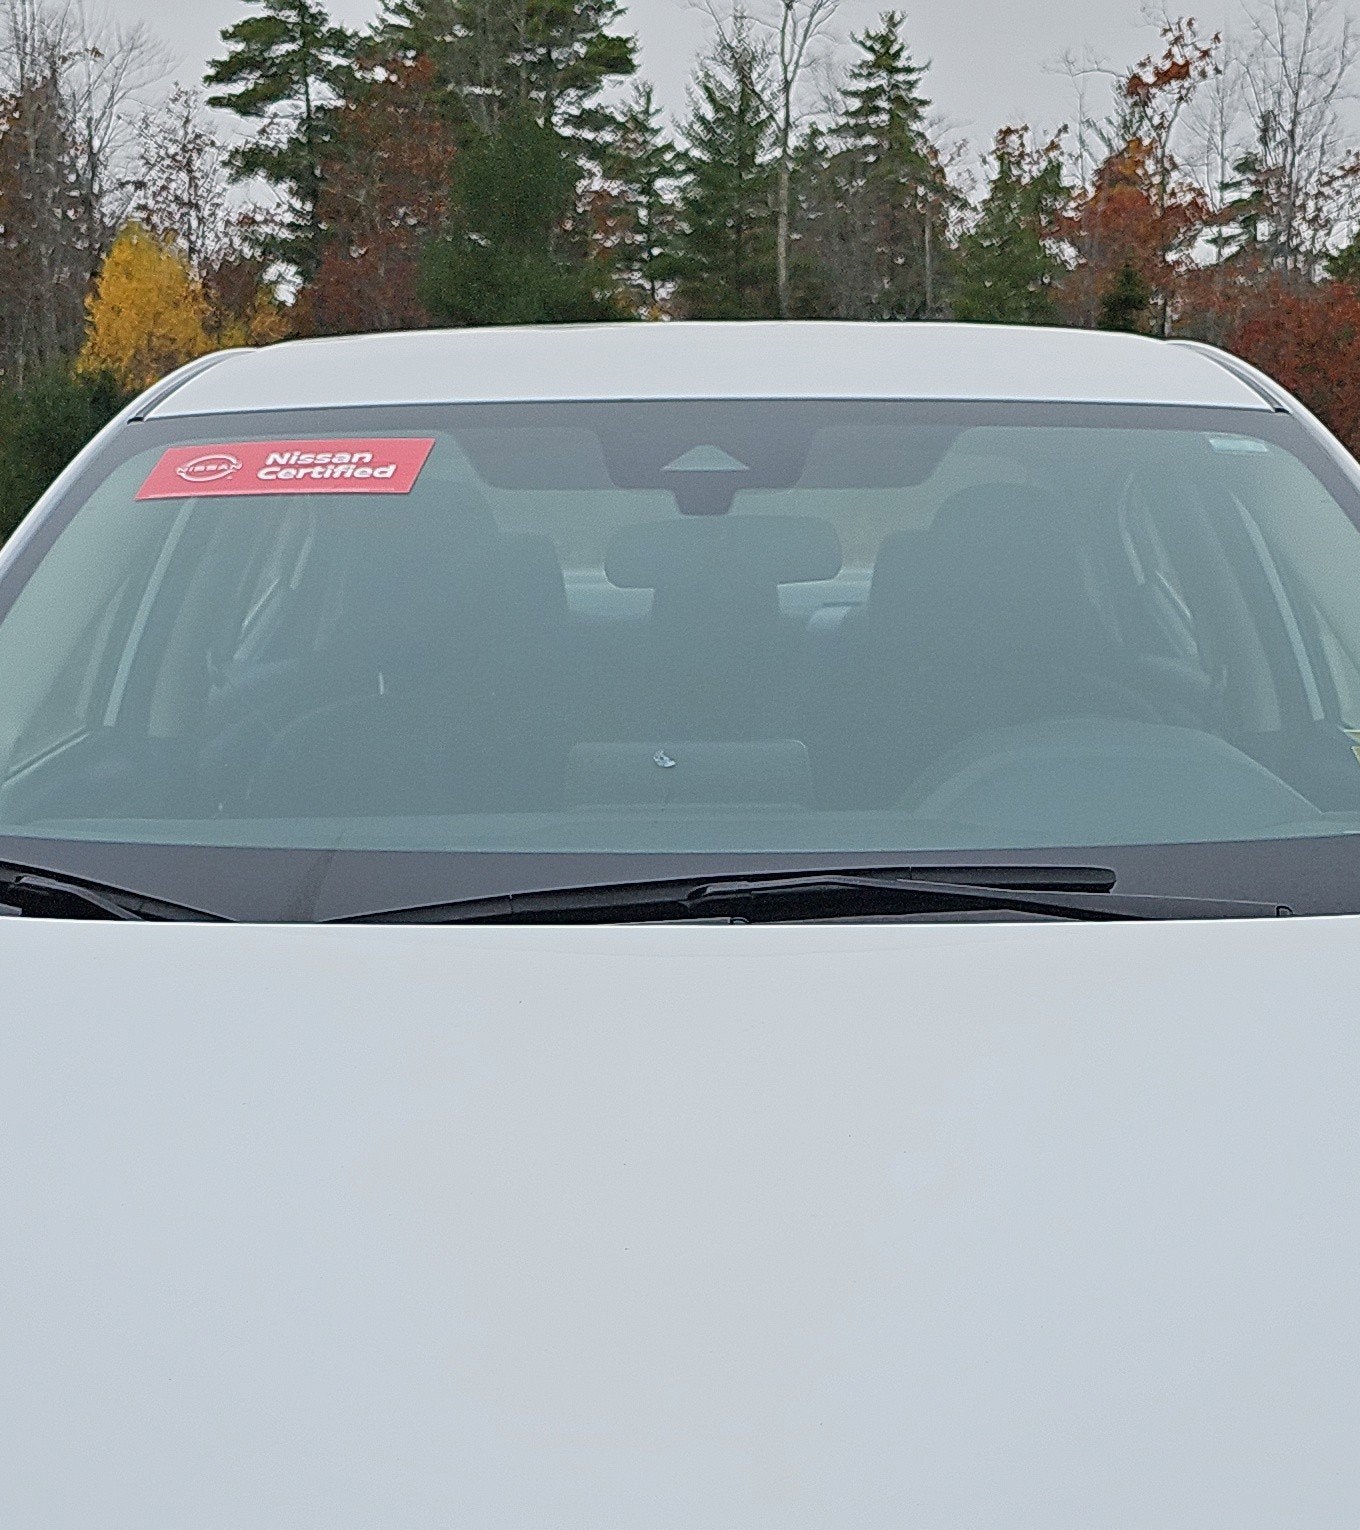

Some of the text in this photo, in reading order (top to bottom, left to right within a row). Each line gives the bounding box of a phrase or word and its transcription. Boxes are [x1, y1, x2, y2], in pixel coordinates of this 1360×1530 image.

[265, 451, 373, 465] Nissan
[176, 461, 242, 475] NISSAN
[256, 464, 395, 480] Certified
